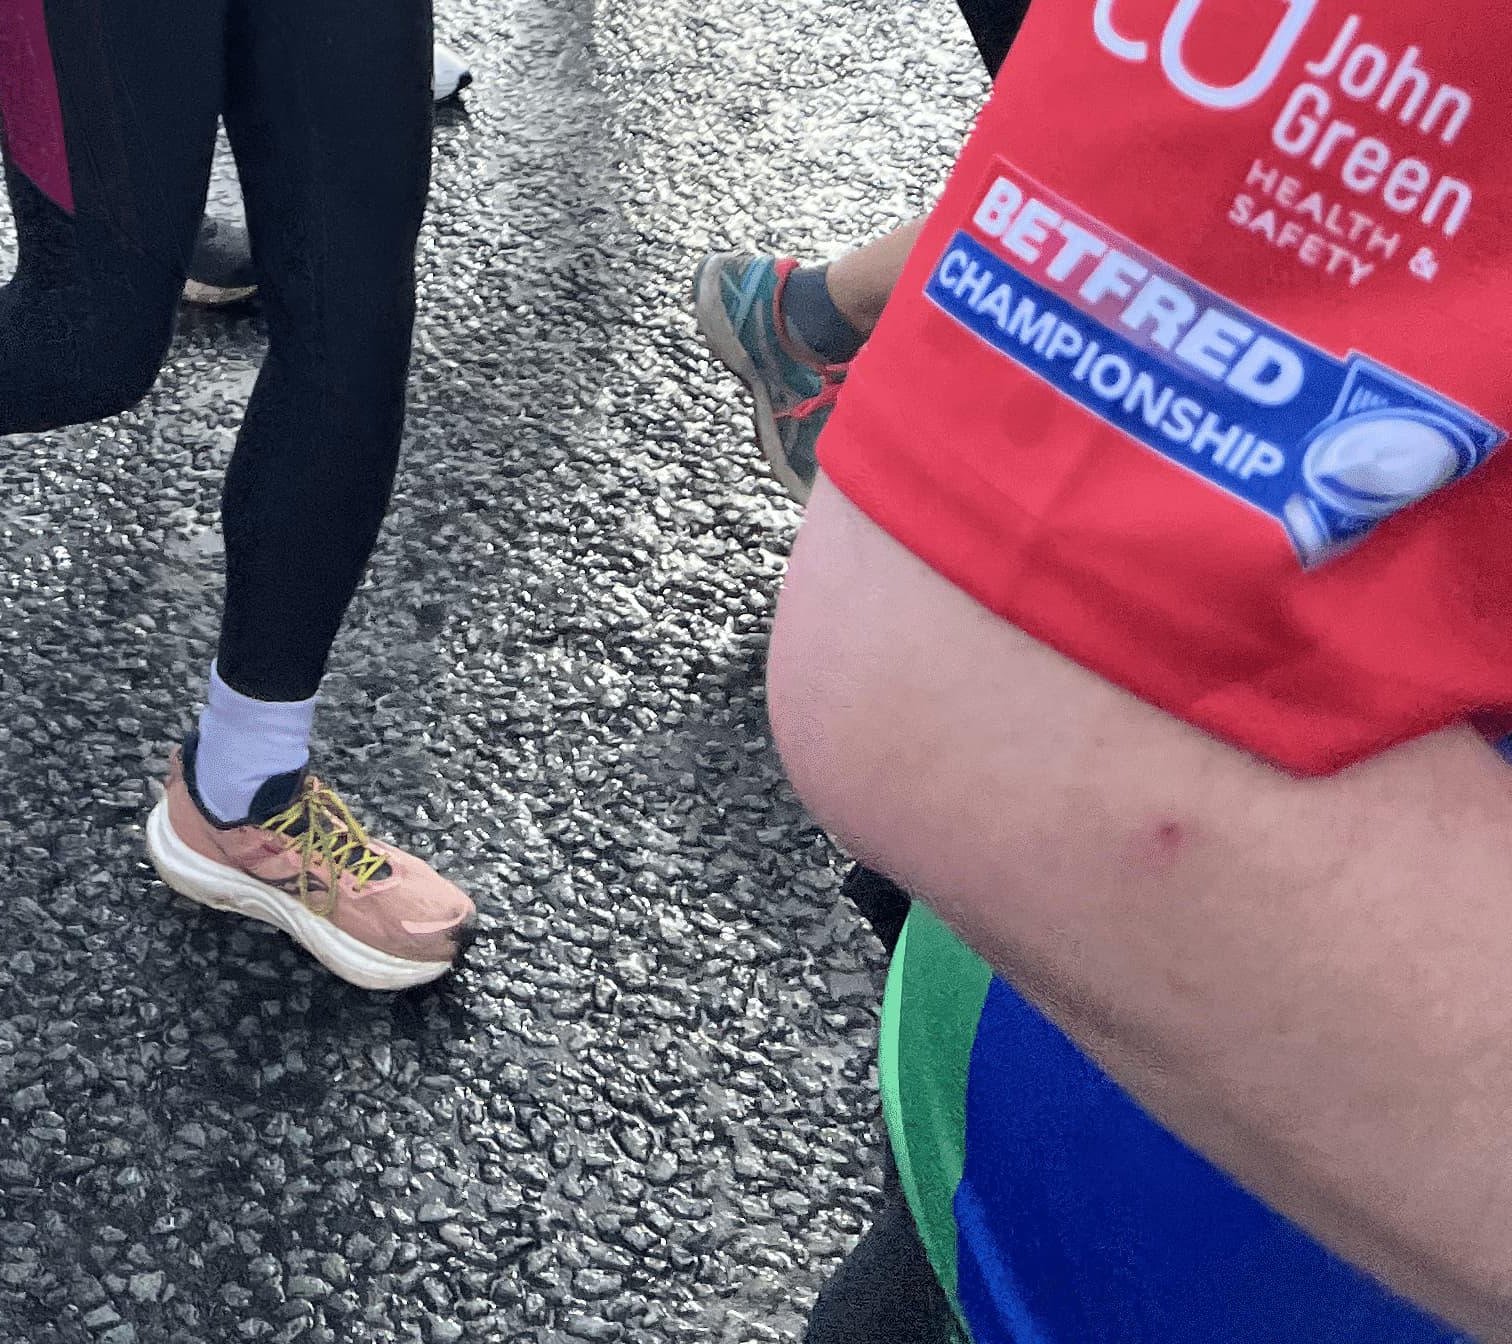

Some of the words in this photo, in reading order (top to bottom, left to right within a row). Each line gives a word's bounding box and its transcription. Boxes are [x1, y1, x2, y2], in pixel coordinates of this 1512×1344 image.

[1304, 14, 1473, 144] John
[1228, 148, 1375, 288] SAFETY
[1245, 159, 1401, 260] HEALTH
[1408, 246, 1439, 282] &
[1271, 81, 1474, 238] Green
[937, 248, 1286, 481] CHAMPIONSHIP
[972, 175, 1306, 407] BETFRED
